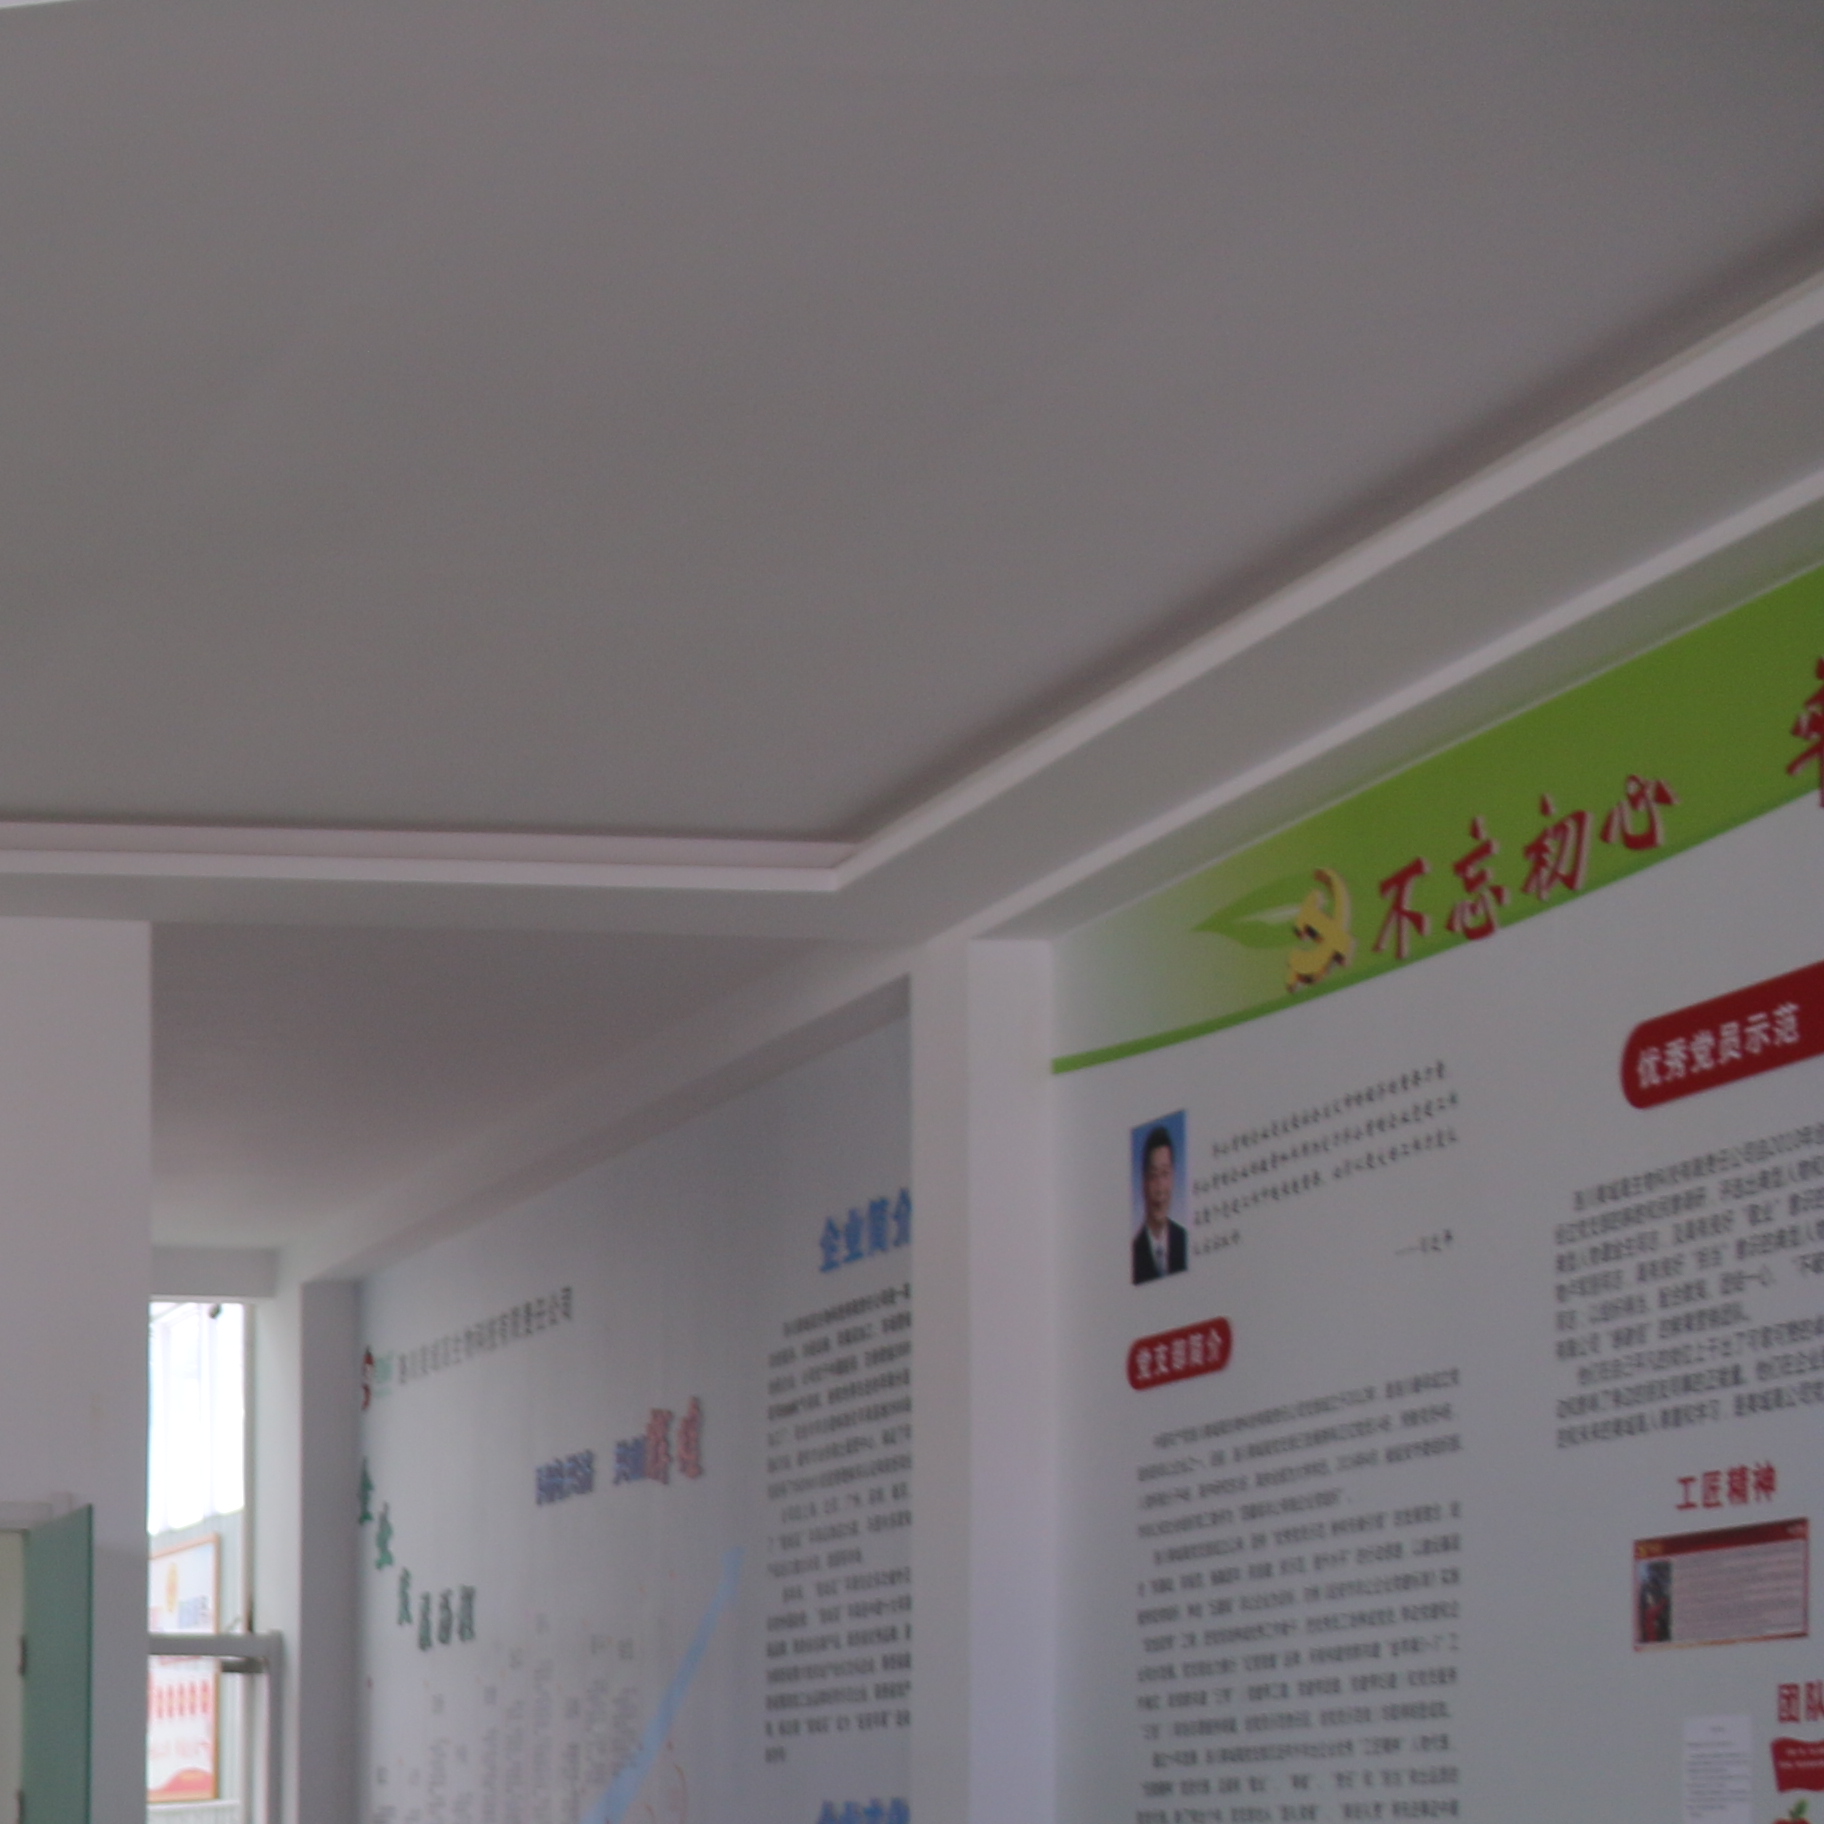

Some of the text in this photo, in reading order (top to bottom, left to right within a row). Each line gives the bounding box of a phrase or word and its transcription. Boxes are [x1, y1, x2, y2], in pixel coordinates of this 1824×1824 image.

[1371, 773, 1678, 960] 不忘初心
[1636, 1002, 1800, 1089] 优秀党员示范
[1676, 1460, 1778, 1512] 工匠精神
